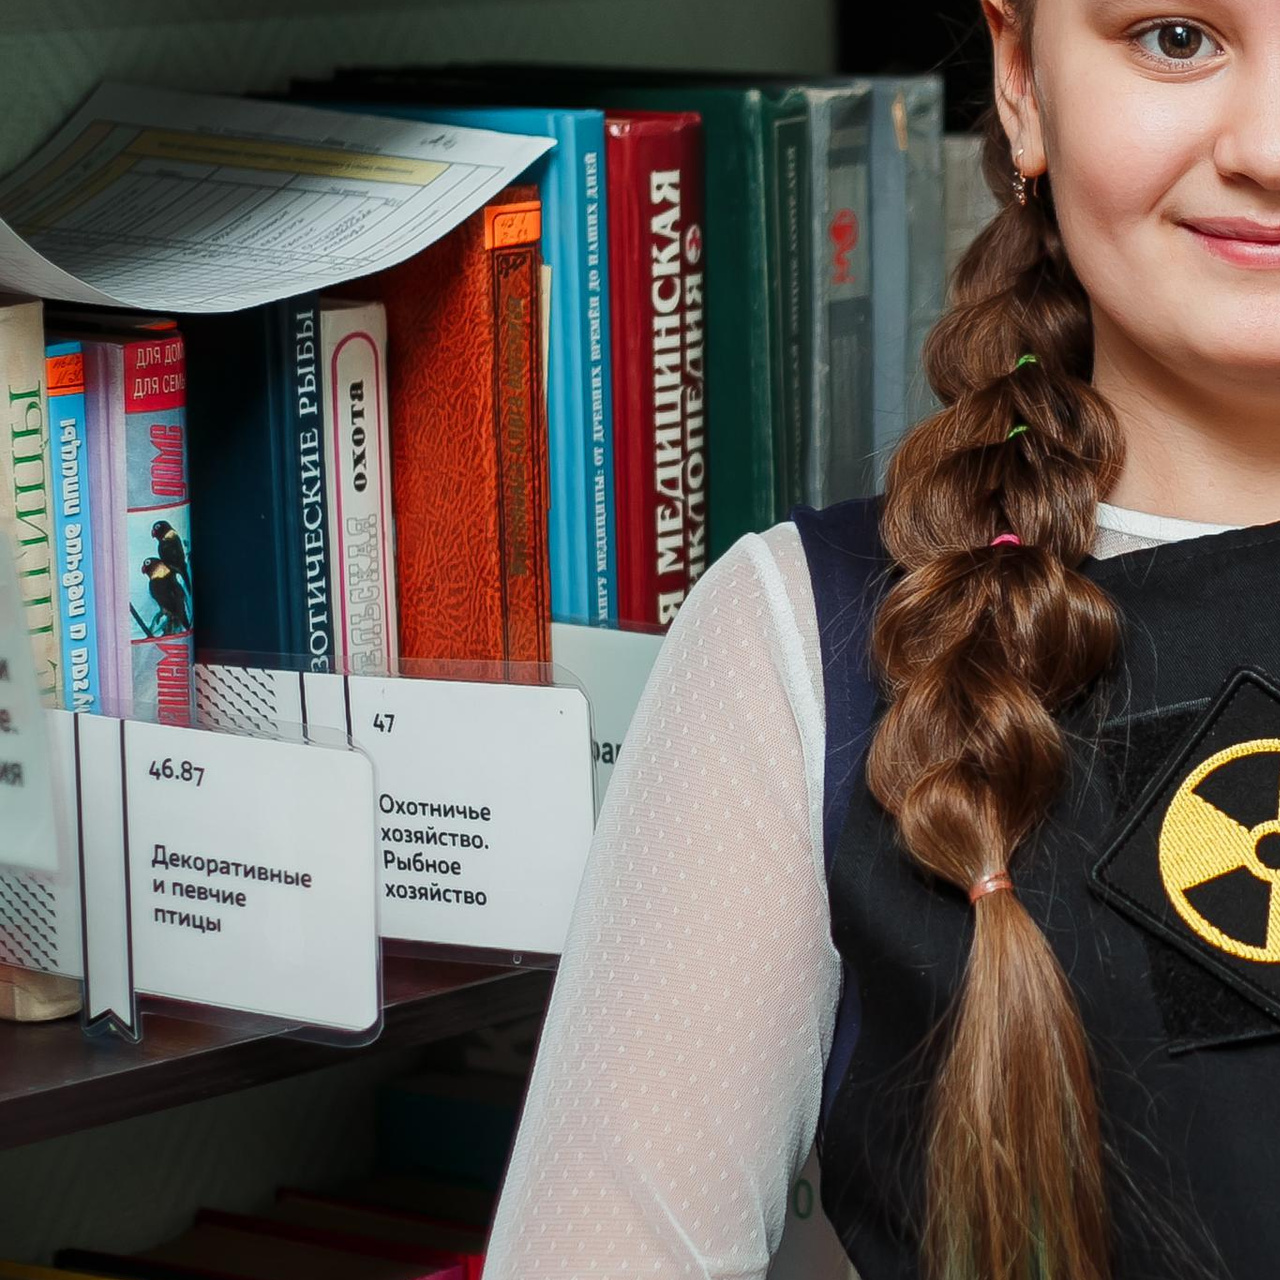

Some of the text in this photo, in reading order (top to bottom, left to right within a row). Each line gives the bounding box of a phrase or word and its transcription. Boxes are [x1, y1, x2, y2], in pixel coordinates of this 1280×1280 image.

[582, 151, 599, 198] ДНЕЙ
[585, 200, 600, 266] НАШИХ
[588, 270, 603, 293] ДО
[135, 346, 162, 369] ДЛЯ
[295, 308, 318, 418] РЫБЫ
[649, 169, 685, 575] МЕДИЦИНСКАЯ
[133, 376, 160, 400] ДЛЯ
[590, 363, 606, 443] ДРЕВНИХ
[348, 380, 368, 494] охота
[59, 418, 82, 515] птицы
[592, 445, 605, 466] ОТ
[63, 524, 88, 616] певчие
[596, 577, 609, 621] МИРУ
[69, 623, 87, 641] и
[372, 712, 396, 734] 47
[148, 757, 206, 788] 46.87
[378, 793, 492, 822] Охотничье
[380, 825, 490, 851] хозяйство.
[151, 843, 313, 889] Декоративные
[382, 849, 462, 876] Рыбное
[153, 878, 248, 908] и певчие
[384, 882, 488, 907] хозяйство
[153, 907, 222, 934] птицы
